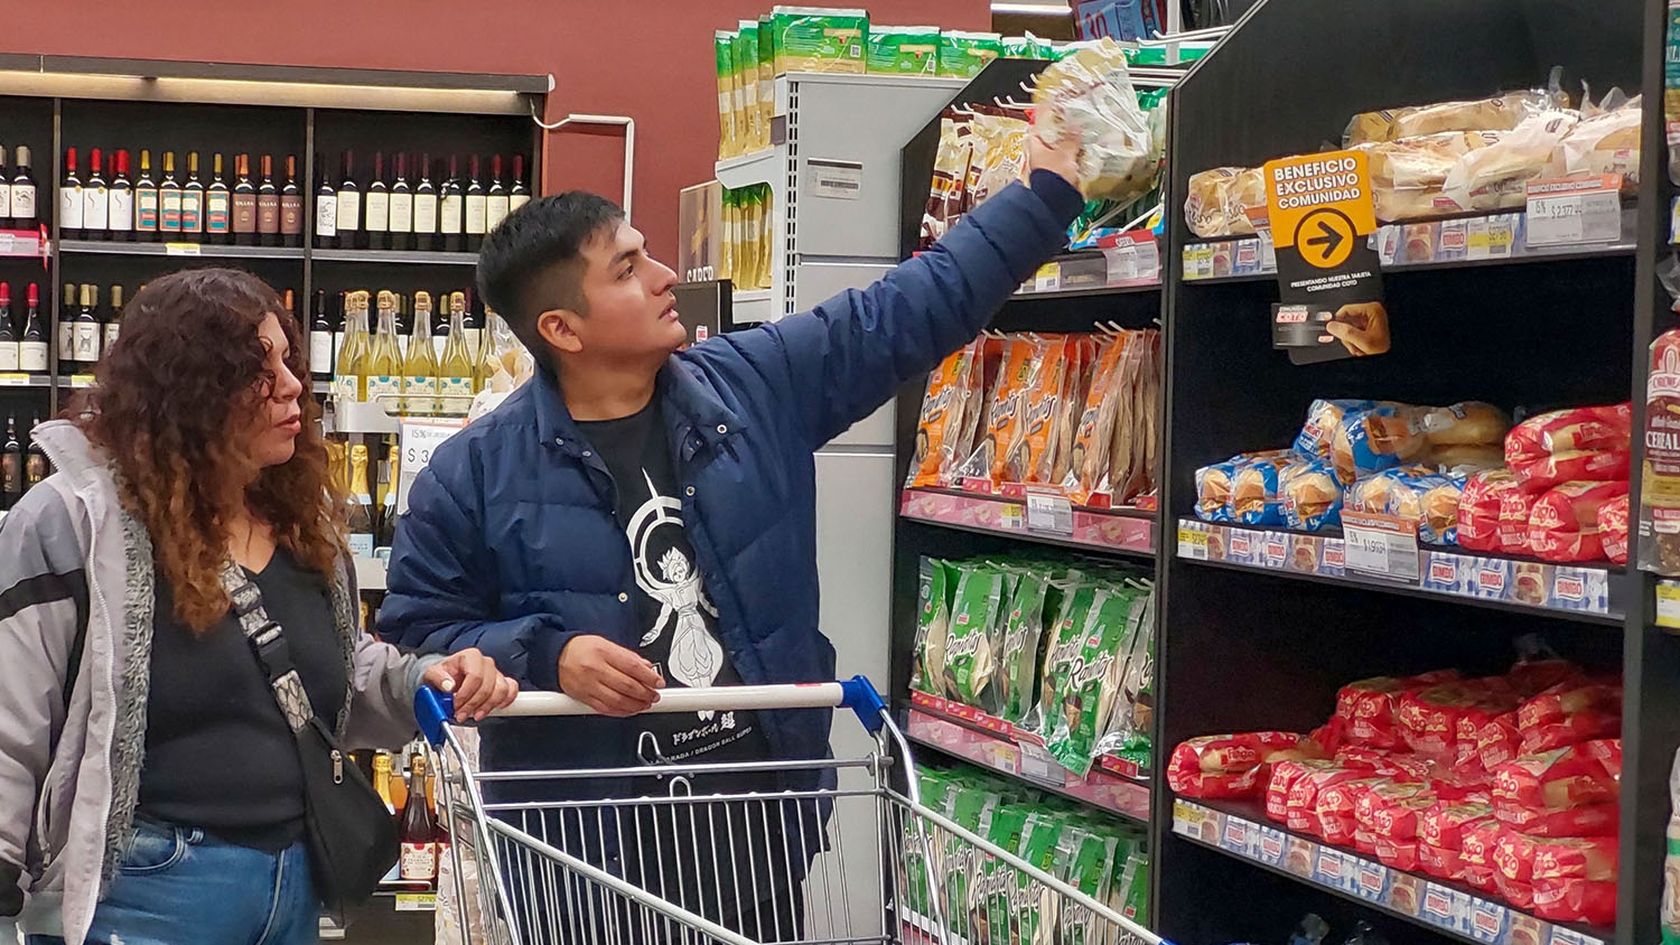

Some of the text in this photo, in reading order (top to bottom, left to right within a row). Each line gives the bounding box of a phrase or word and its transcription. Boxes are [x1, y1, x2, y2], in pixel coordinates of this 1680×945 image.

[1274, 157, 1356, 181] BENEFICIO
[1276, 173, 1358, 196] EXCLUSIVO
[1278, 188, 1360, 209] COMUNIDAD
[407, 447, 416, 463] $
[1432, 566, 1455, 580] BIMBO
[1480, 573, 1503, 588] BIMBO
[1557, 580, 1582, 595] BIMBO
